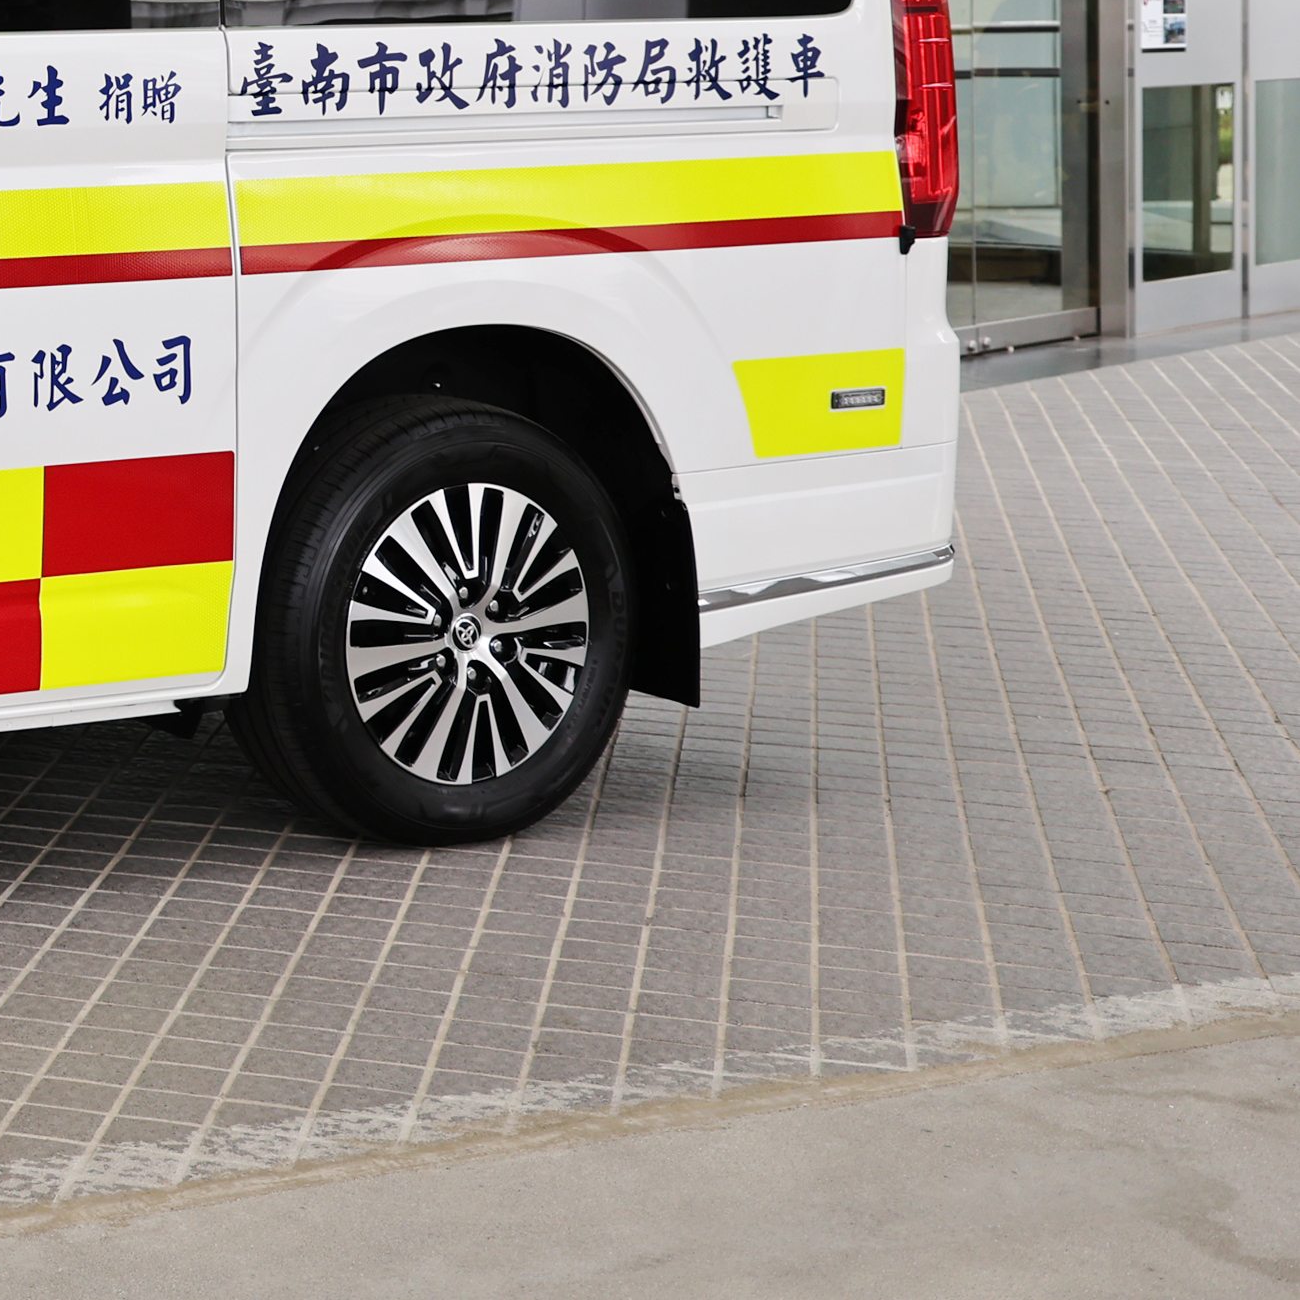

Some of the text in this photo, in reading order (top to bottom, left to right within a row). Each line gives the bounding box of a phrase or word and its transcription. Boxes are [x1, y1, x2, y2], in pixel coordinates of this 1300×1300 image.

[98, 70, 183, 125] 捐贈
[239, 32, 826, 117] 臺南市政府消防局救護車
